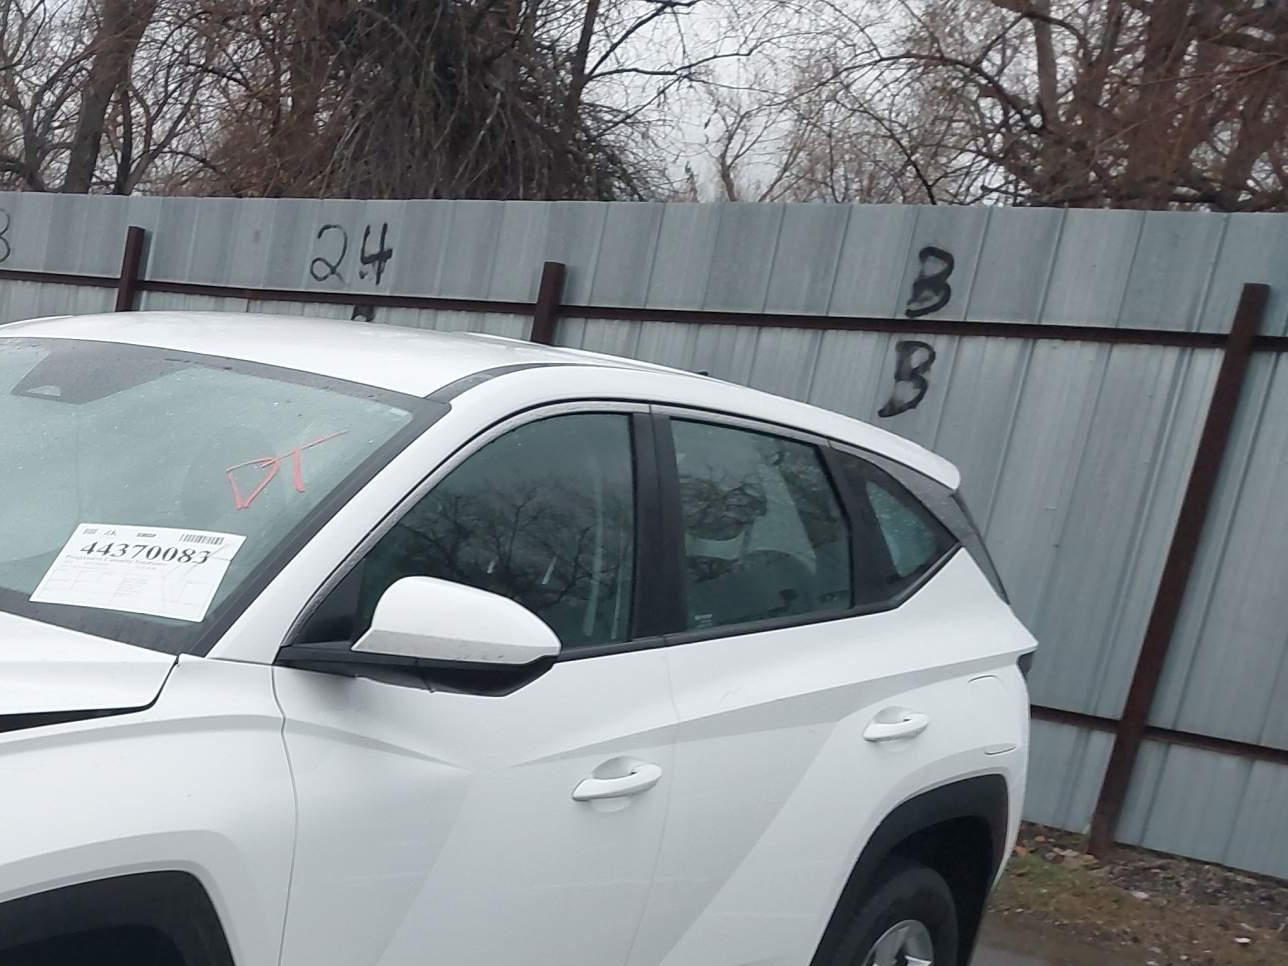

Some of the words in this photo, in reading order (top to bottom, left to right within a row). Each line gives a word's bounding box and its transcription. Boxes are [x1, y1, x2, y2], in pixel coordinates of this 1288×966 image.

[310, 222, 393, 286] 24
[878, 340, 936, 418] B
[80, 541, 211, 565] 44370083
